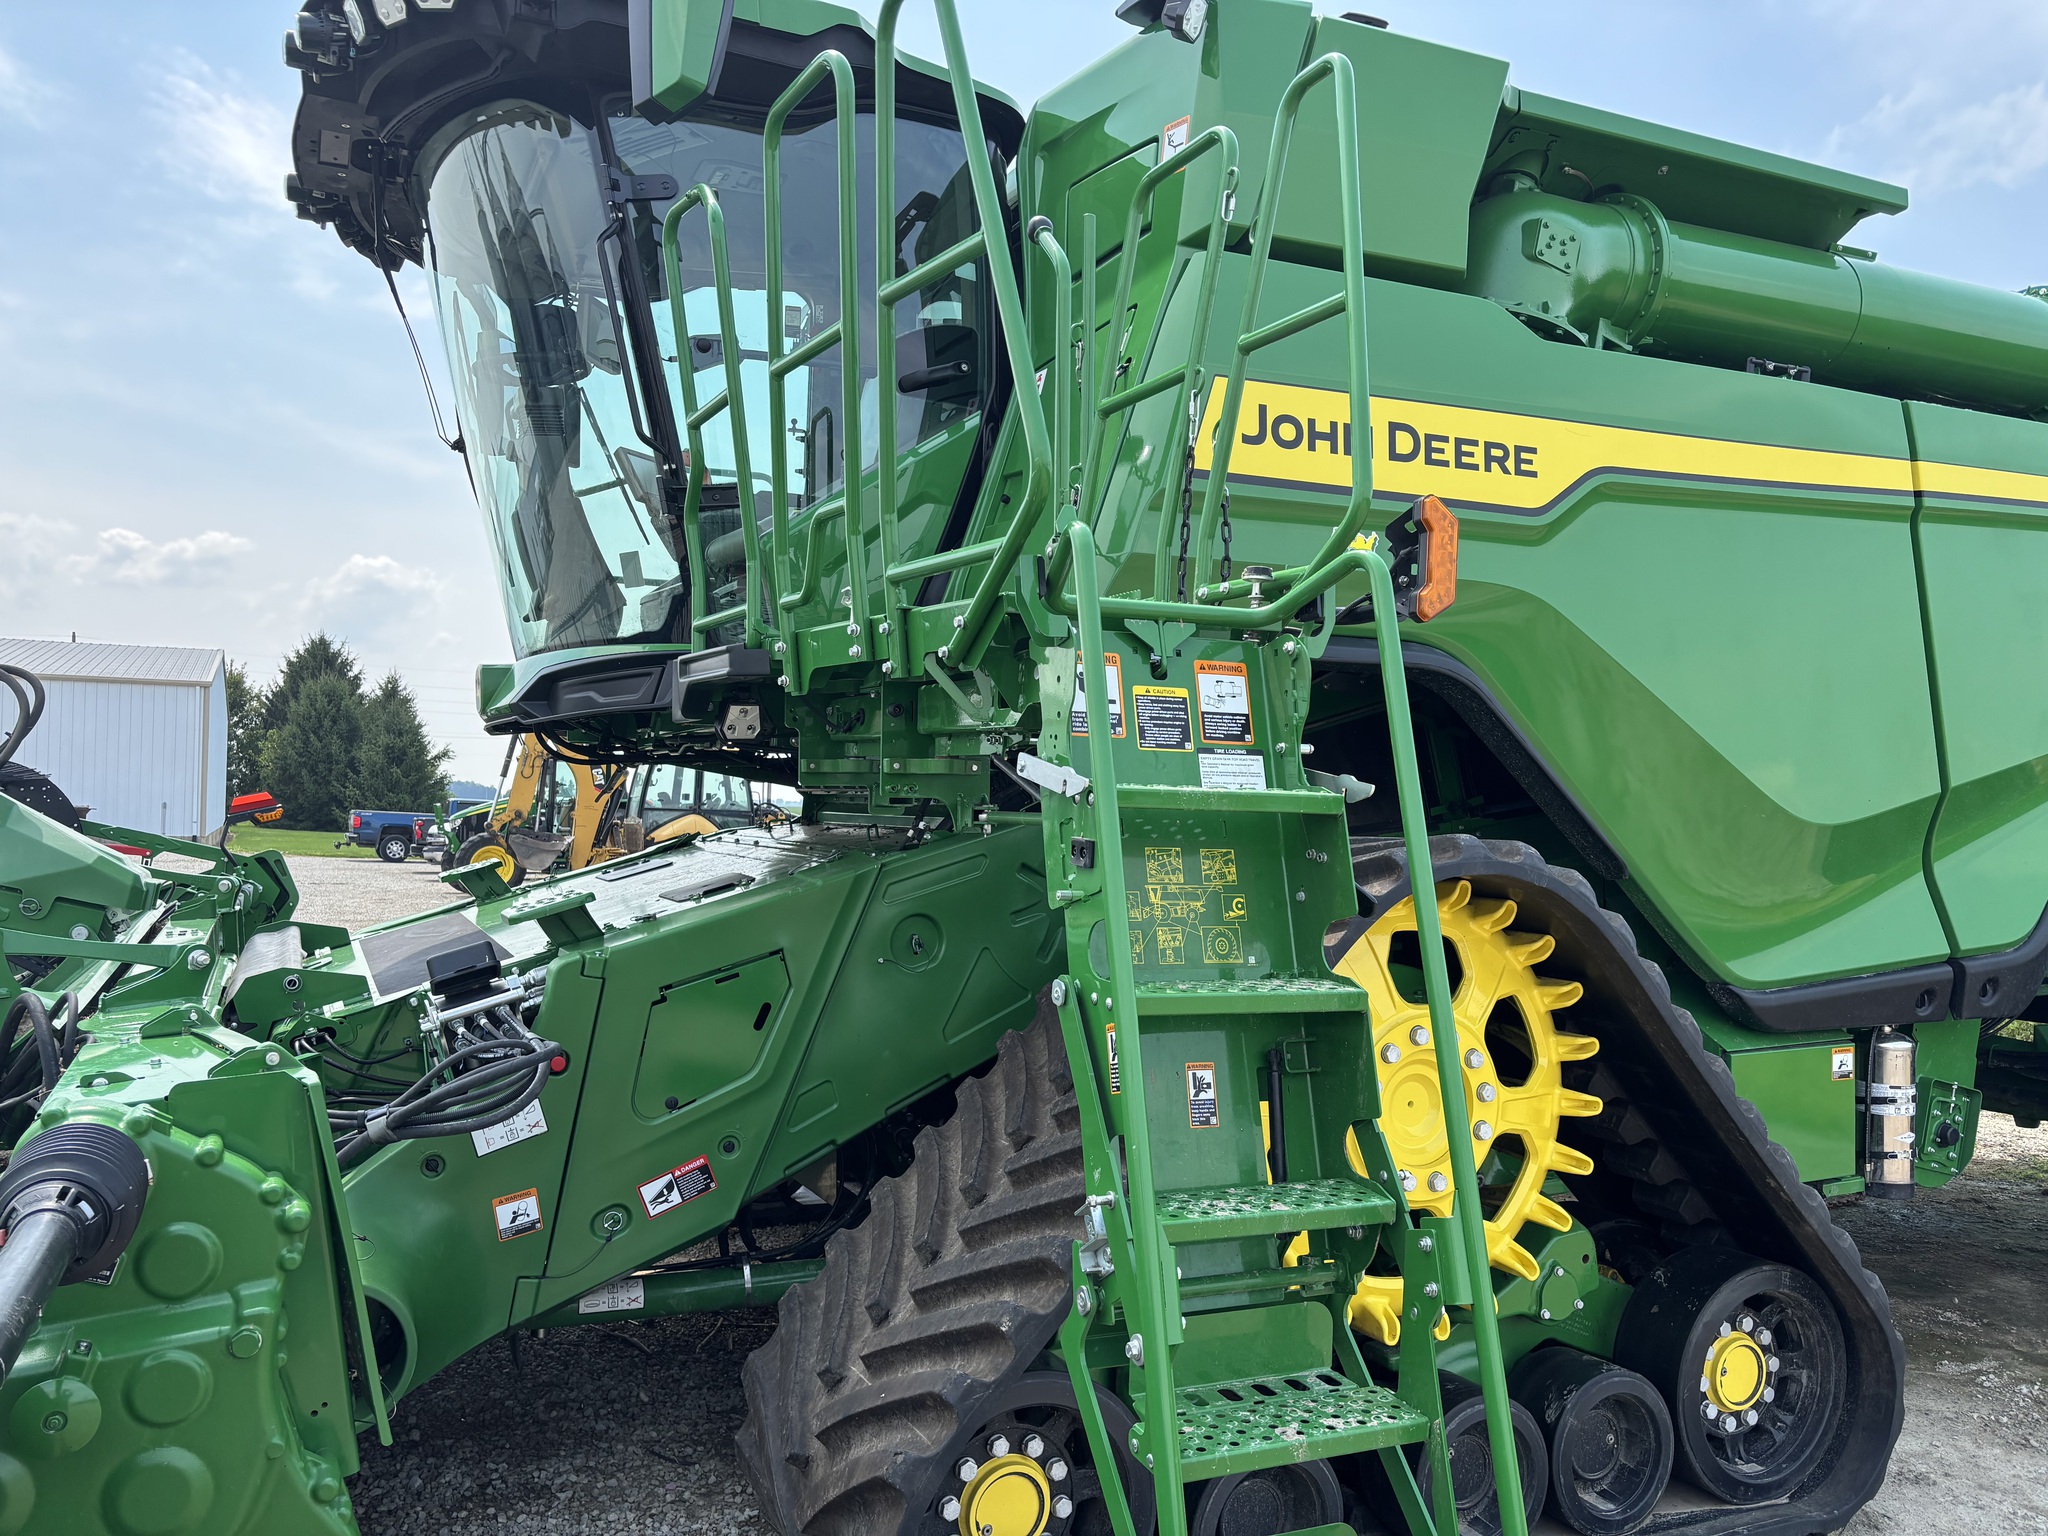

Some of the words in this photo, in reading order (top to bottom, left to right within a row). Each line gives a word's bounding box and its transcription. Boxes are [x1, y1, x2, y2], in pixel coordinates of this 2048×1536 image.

[1388, 420, 1538, 478] DEERE
[1206, 664, 1243, 673] WARNING
[592, 768, 604, 785] CAT
[680, 1158, 705, 1173] DANGER
[504, 1191, 532, 1202] WARNING
